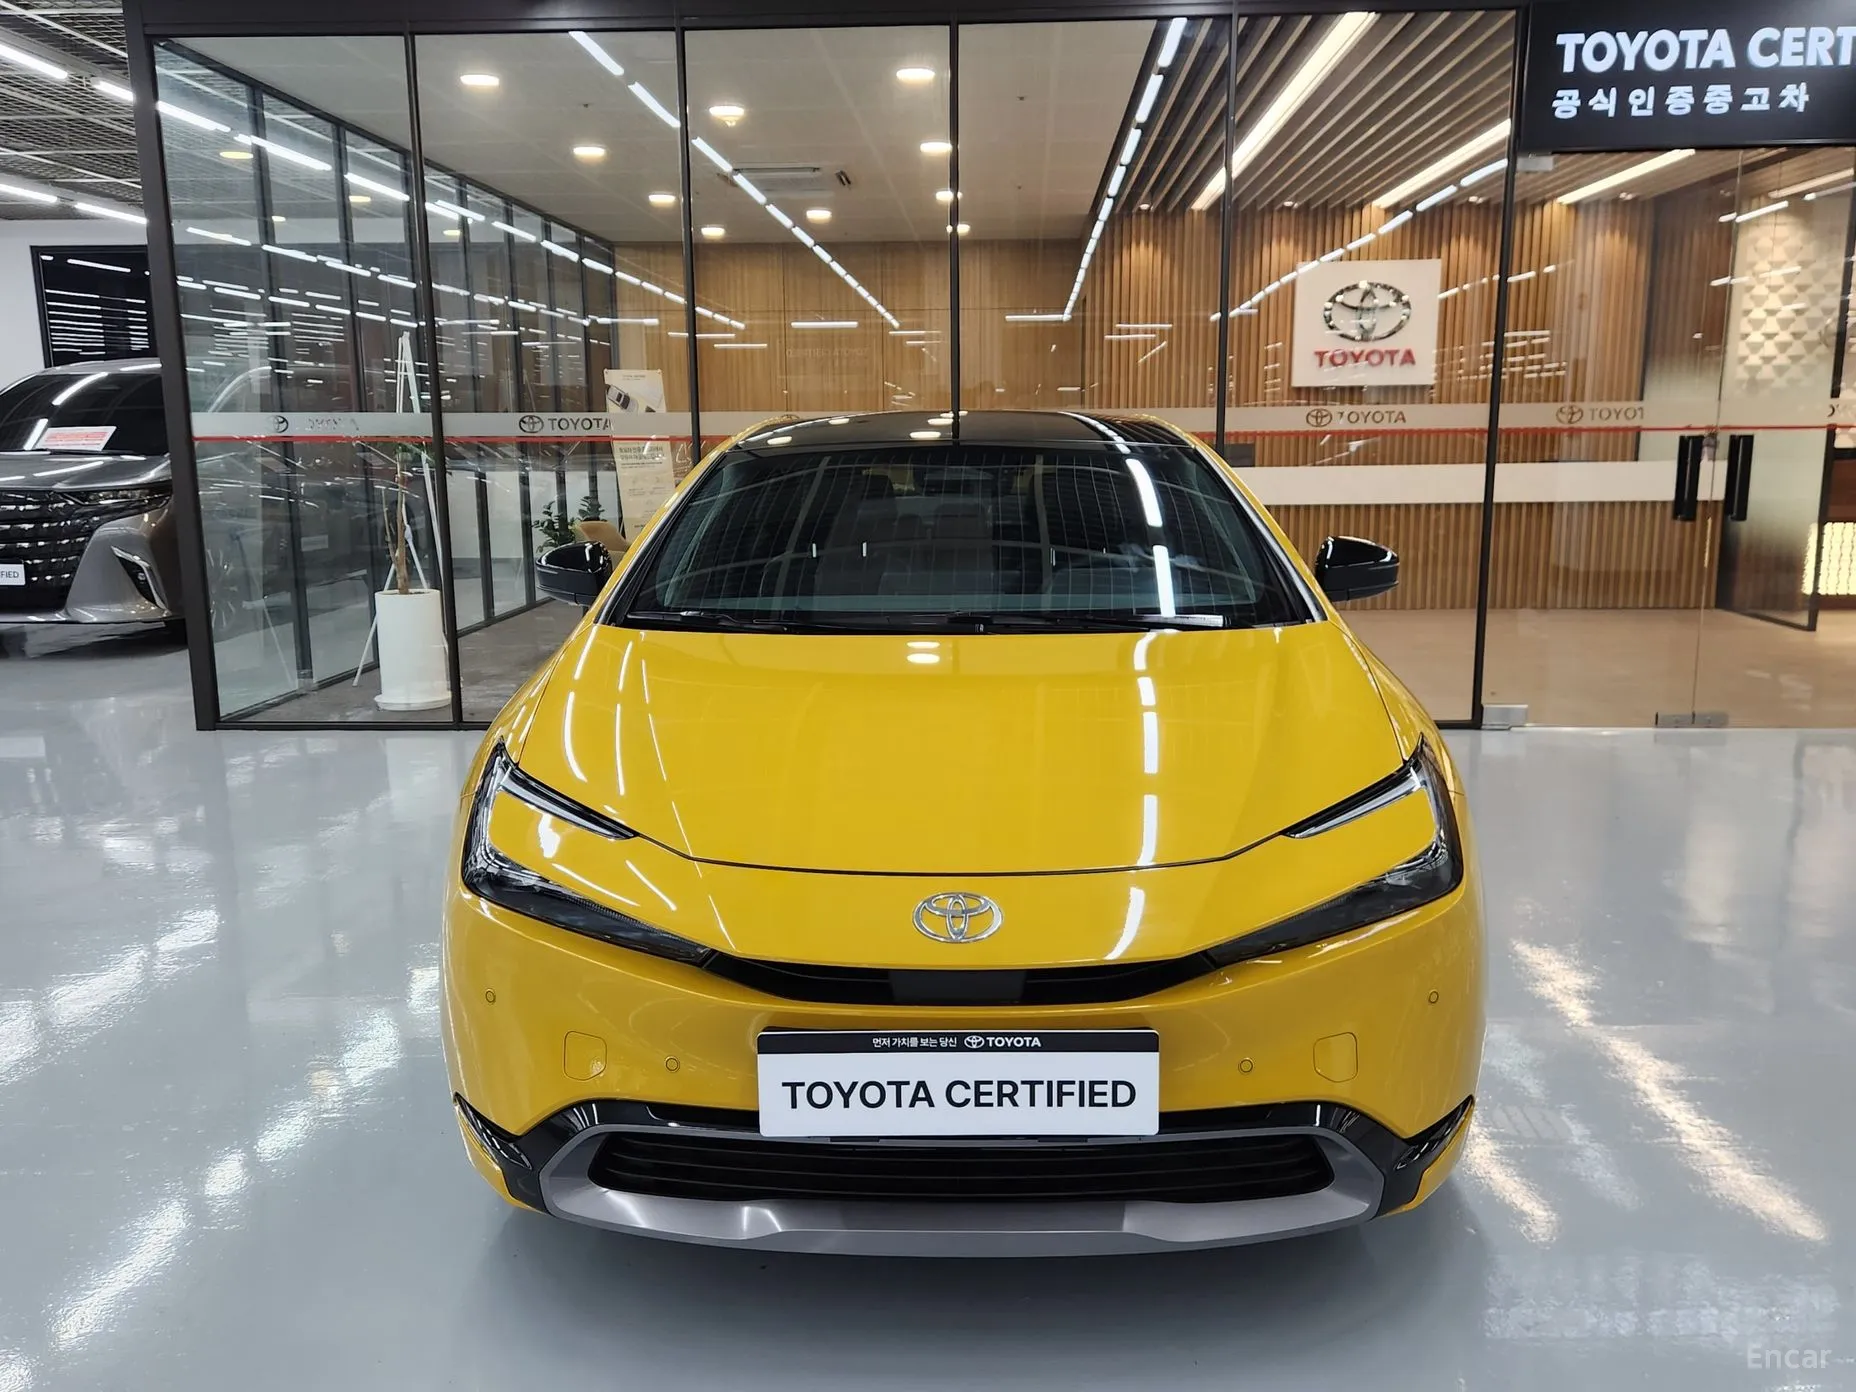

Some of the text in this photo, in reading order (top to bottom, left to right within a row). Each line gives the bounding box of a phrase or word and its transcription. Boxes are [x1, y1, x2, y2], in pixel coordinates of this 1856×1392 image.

[1556, 24, 1856, 73] TOYOTA CERT
[1313, 348, 1417, 368] TOYOTA
[1337, 410, 1407, 424] TOYOTA
[1589, 406, 1644, 421] TOYOT
[548, 418, 612, 431] TOYOTA
[872, 1037, 957, 1048] 먼저 가치를 보는 당신
[986, 1036, 1042, 1048] TOYOTA
[781, 1079, 1137, 1110] TOYOTA CERTIFIED
